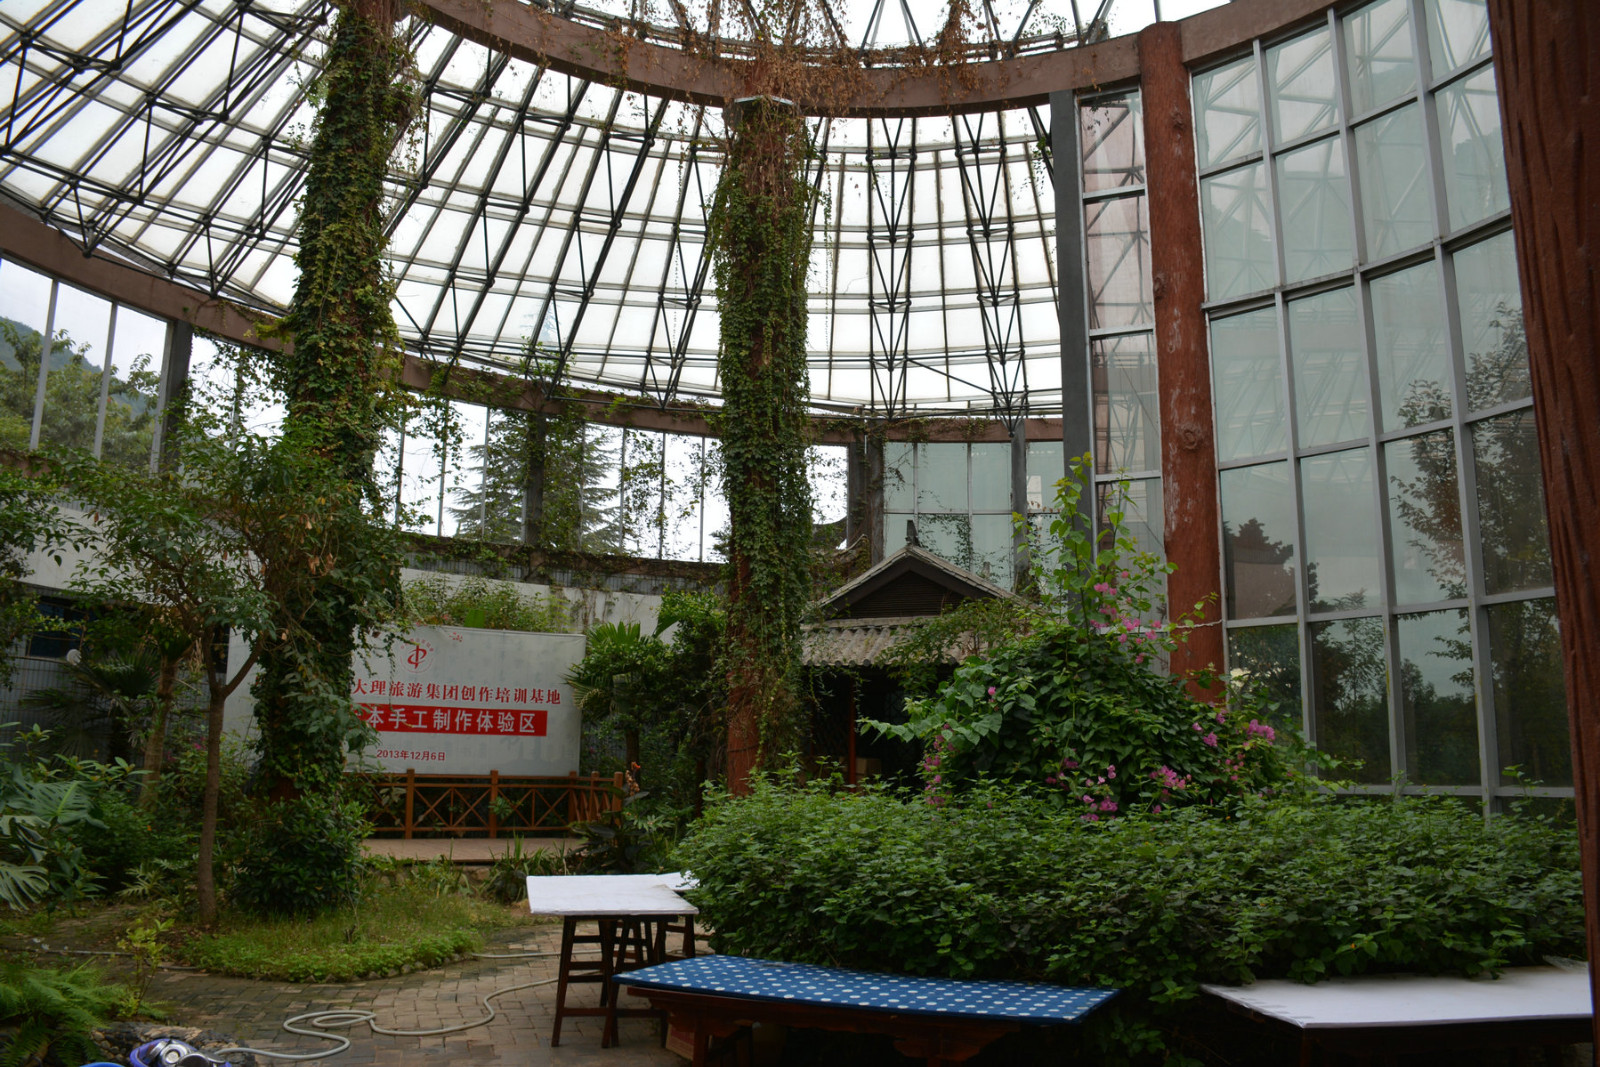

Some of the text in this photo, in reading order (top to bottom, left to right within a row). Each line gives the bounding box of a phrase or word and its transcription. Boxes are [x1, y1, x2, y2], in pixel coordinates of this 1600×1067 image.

[353, 679, 561, 704] 大理旅游集团创作培训基地
[355, 706, 536, 733] 本手工制作体验区
[376, 749, 446, 761] 2013年12月6日
